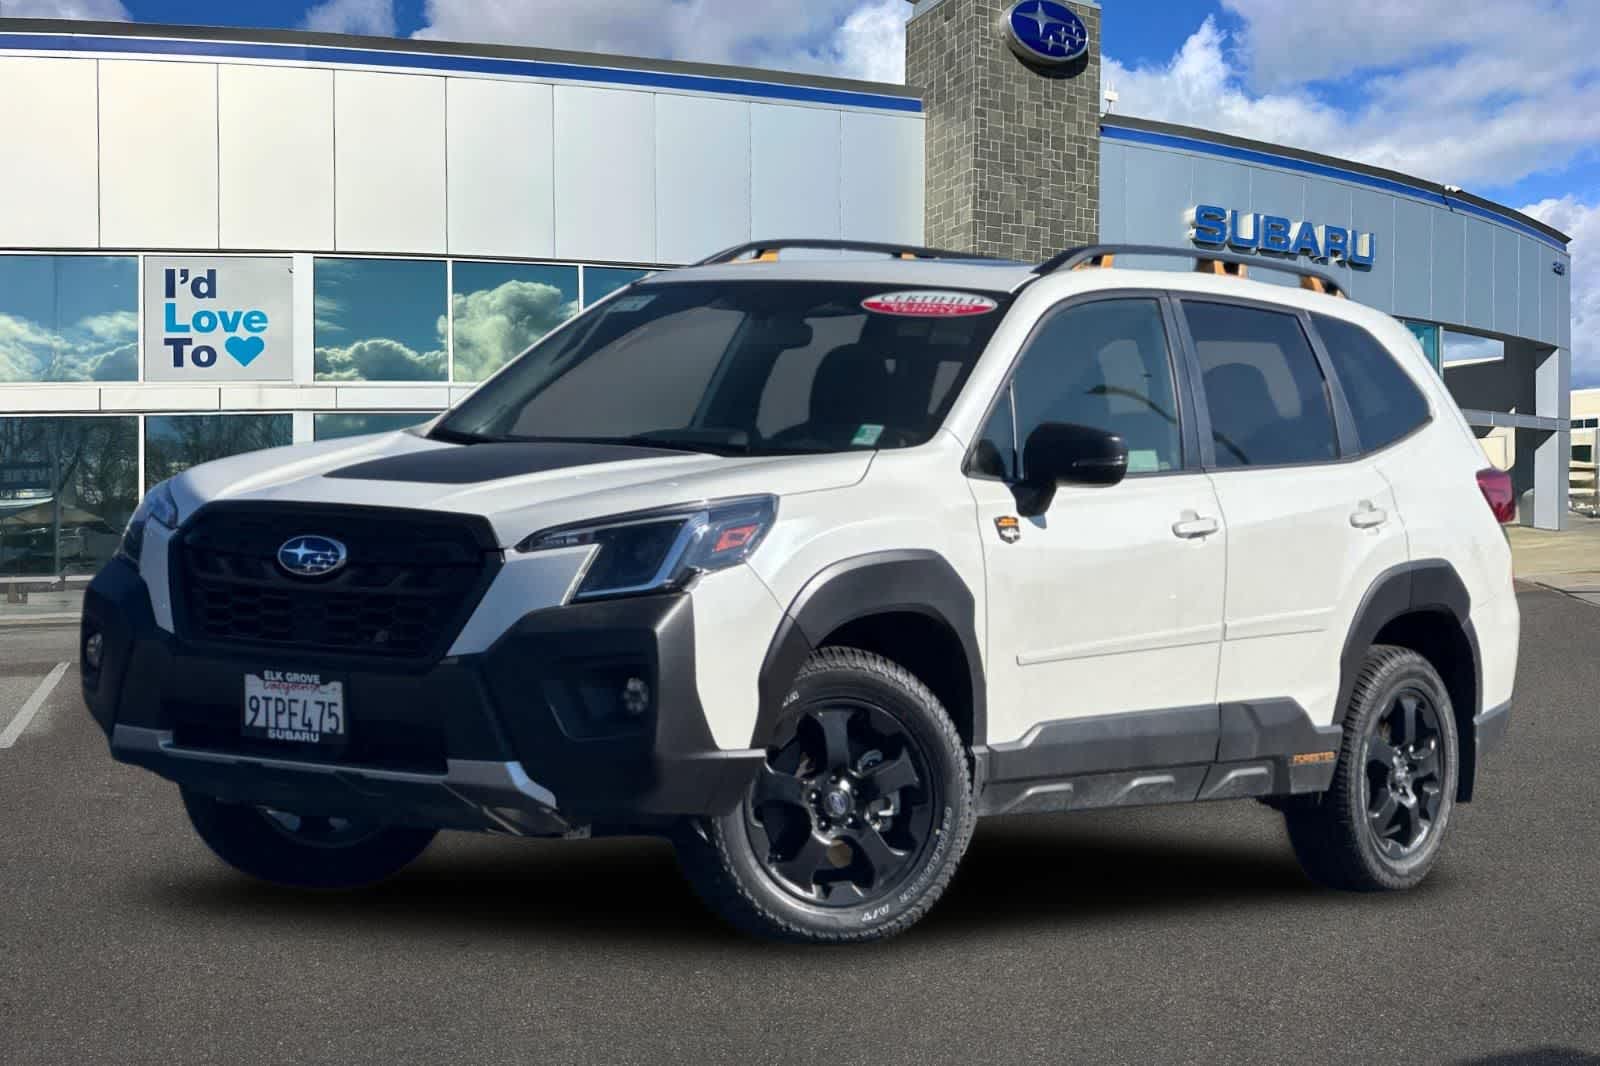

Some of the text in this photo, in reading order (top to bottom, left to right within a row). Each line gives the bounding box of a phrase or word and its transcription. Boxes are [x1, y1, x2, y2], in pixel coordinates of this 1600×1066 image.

[1191, 204, 1376, 269] SUBARU
[165, 302, 268, 333] Love
[163, 337, 217, 368] To
[263, 669, 321, 685] ELK GROVE
[268, 728, 320, 743] SUBARU
